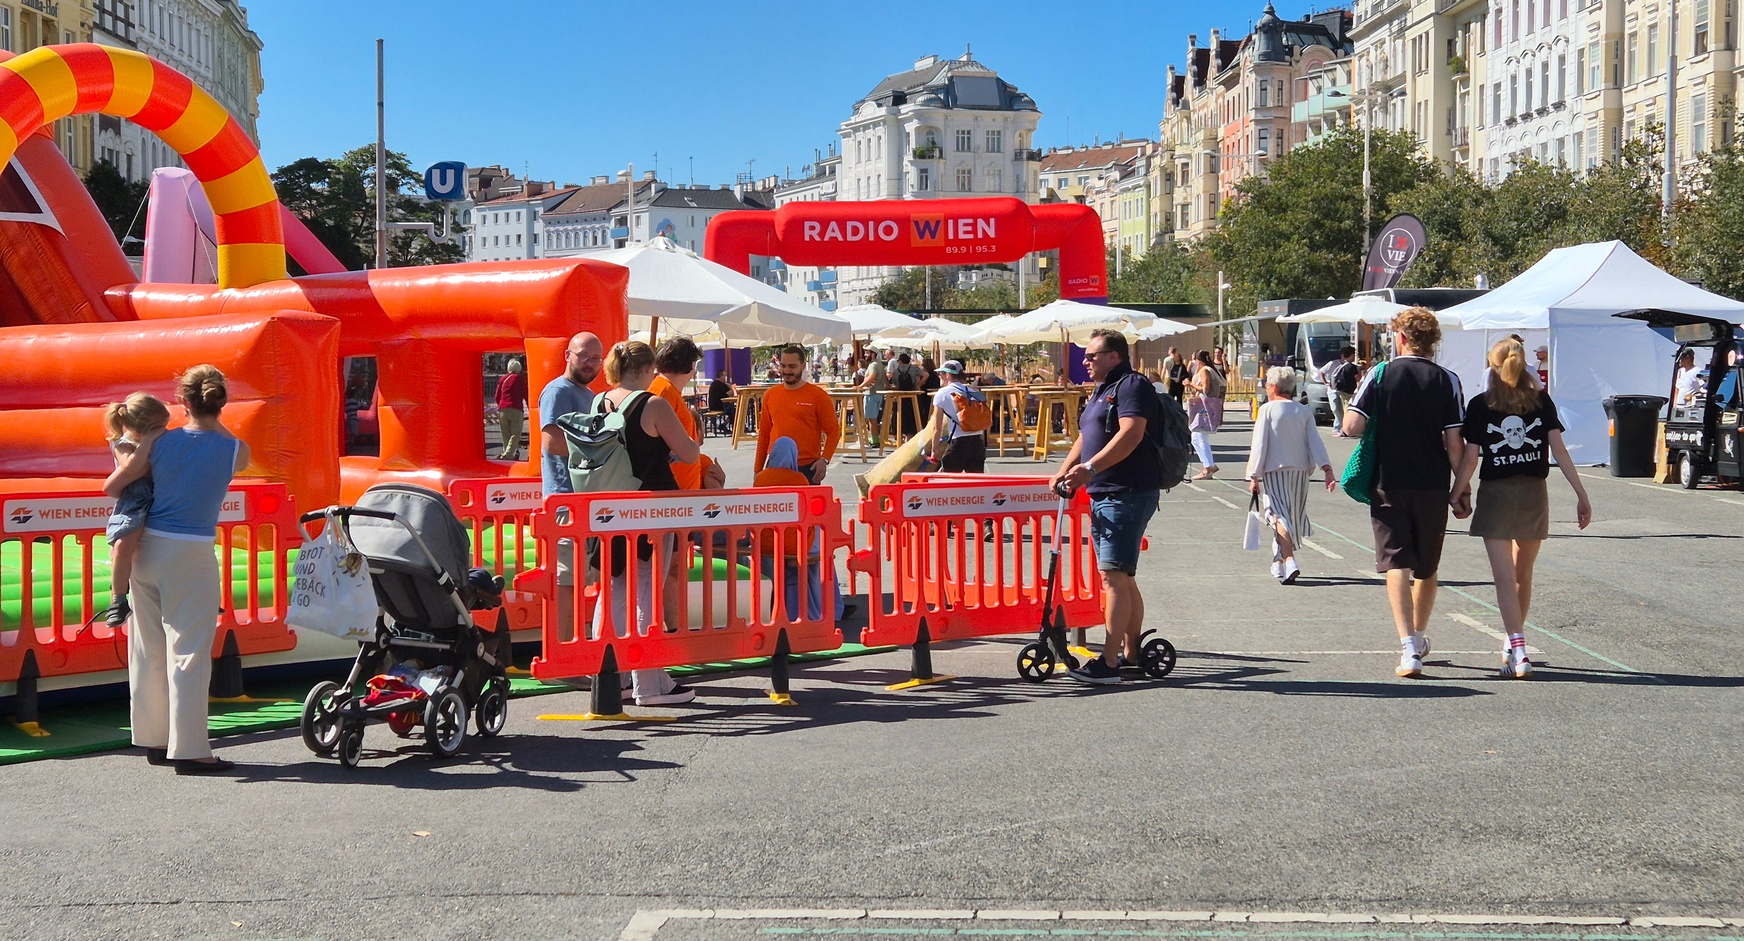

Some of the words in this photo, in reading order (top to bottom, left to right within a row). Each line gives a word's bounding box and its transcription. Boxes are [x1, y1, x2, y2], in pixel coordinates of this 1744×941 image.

[431, 168, 455, 194] U
[803, 220, 899, 242] RADIO
[913, 217, 996, 240] WIEN
[945, 246, 967, 254] 89.9
[975, 245, 996, 253] 95.3
[1387, 250, 1406, 261] VIE
[1493, 451, 1541, 466] ST.PAULI
[510, 492, 532, 500] WIEN
[926, 497, 949, 506] WIEN
[950, 495, 985, 505] ENERGIE
[1009, 494, 1032, 503] WIEN
[1033, 492, 1061, 502] ENERGI
[39, 509, 71, 519] WIEN
[75, 507, 113, 518] ENERG
[619, 508, 648, 520] WIEN
[650, 507, 693, 518] ENERGIE
[725, 504, 751, 515] WIEN
[753, 502, 794, 513] ENERGIE
[295, 562, 316, 575] UND
[294, 576, 326, 598] EBÄCK
[297, 593, 310, 607] GO
